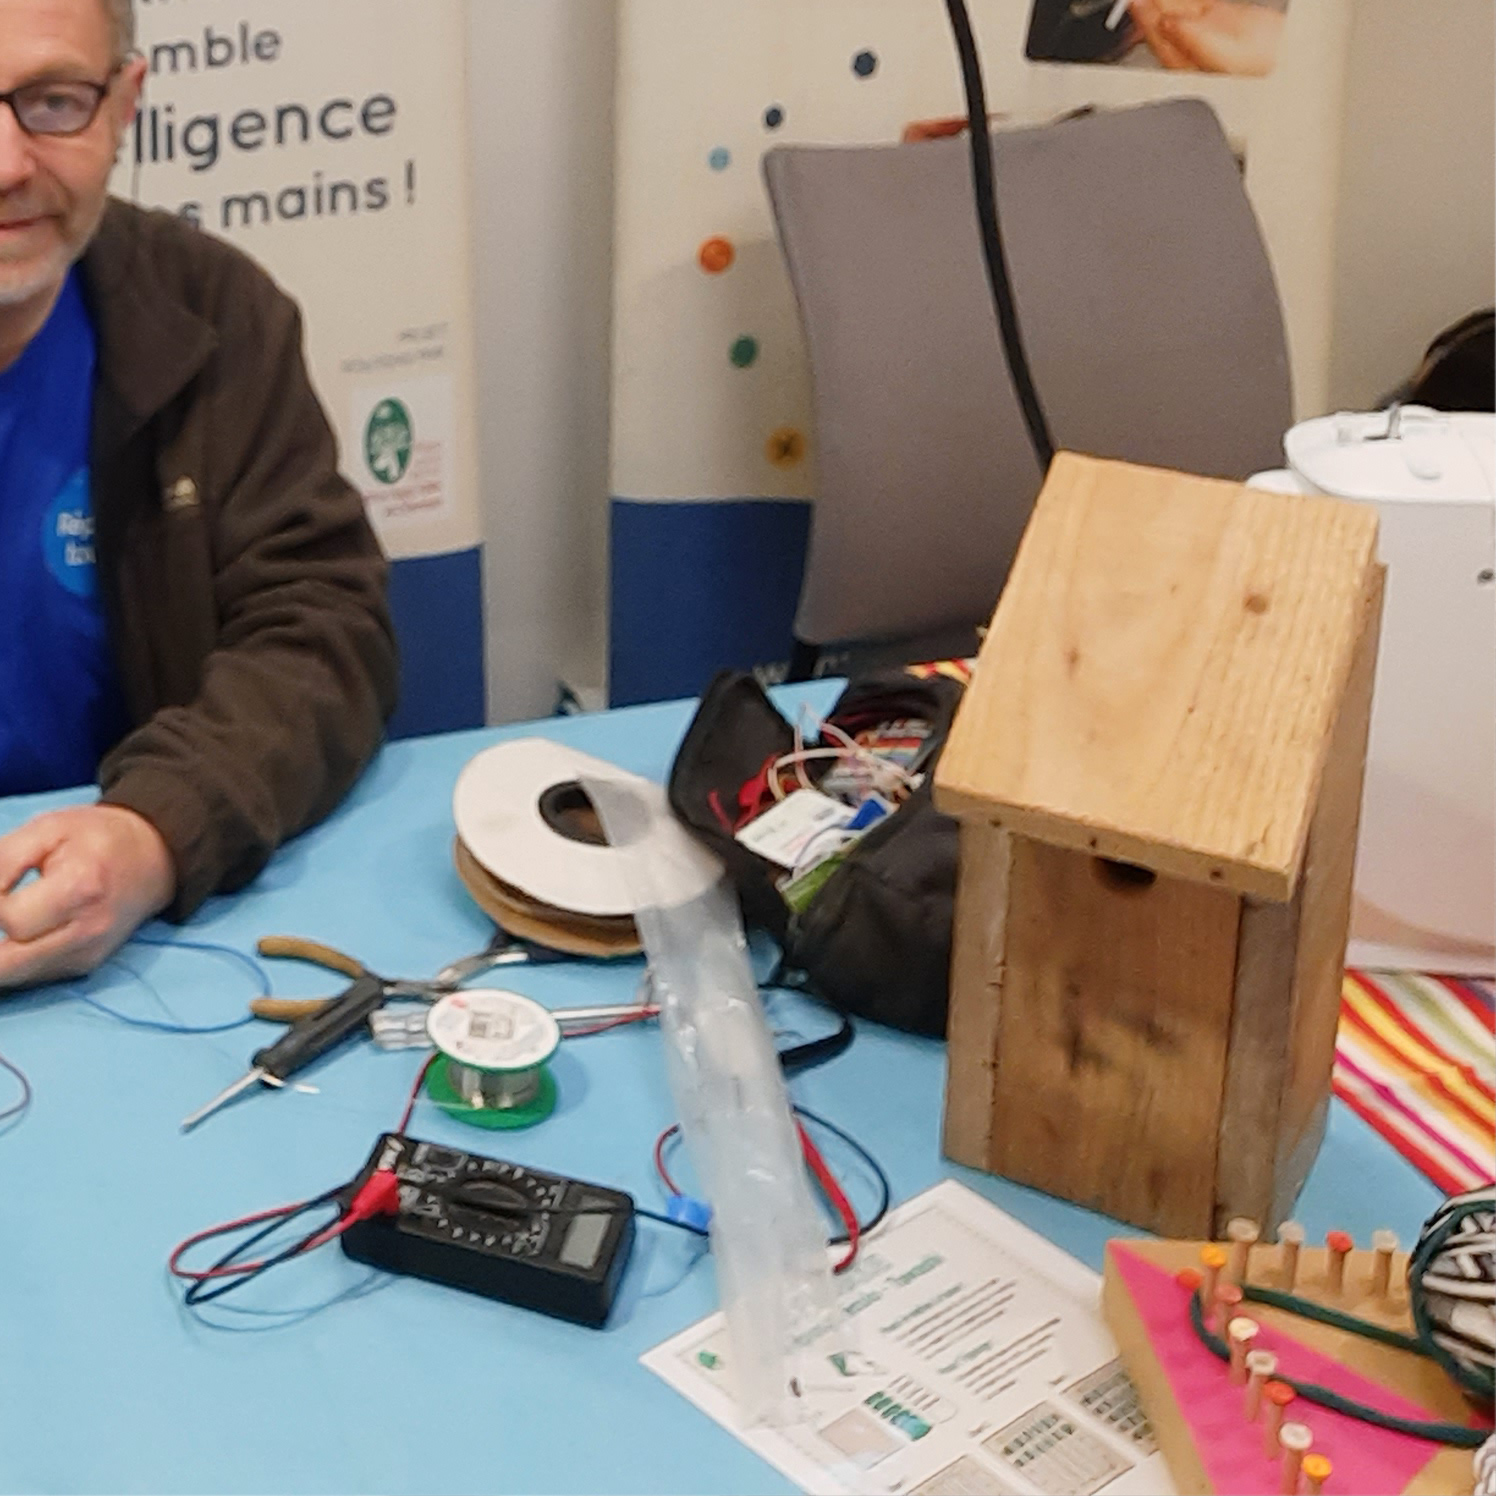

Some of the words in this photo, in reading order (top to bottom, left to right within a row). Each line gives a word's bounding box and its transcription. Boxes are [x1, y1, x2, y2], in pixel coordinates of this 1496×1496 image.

[151, 19, 281, 74] mble
[133, 94, 397, 171] lligence
[222, 171, 389, 228] mains
